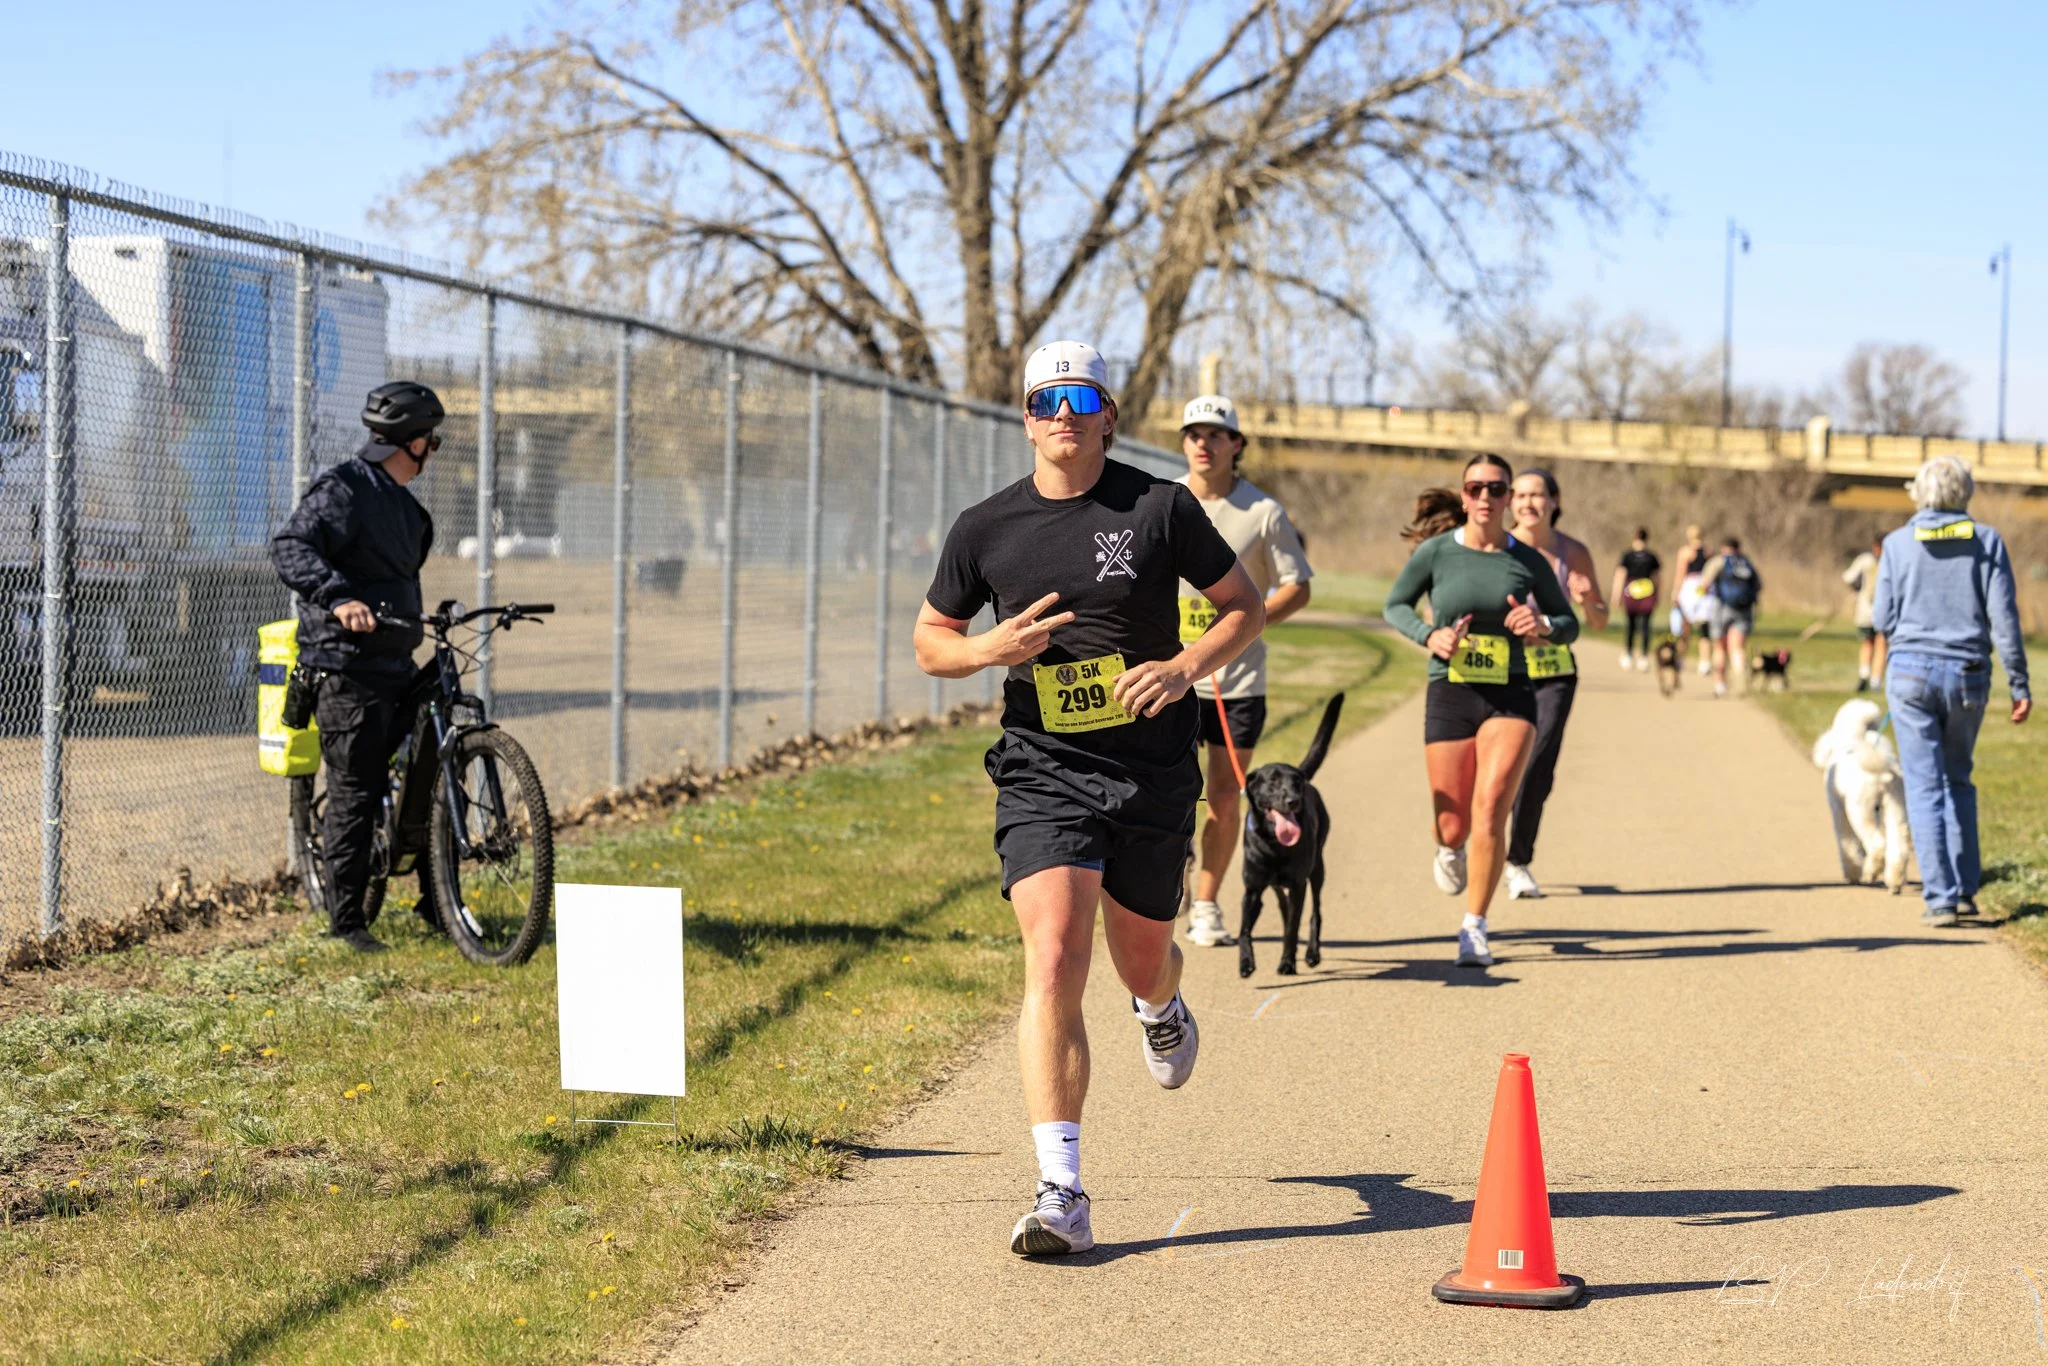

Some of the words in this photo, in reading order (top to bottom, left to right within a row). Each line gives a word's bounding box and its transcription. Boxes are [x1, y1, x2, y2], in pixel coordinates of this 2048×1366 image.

[1056, 361, 1069, 373] 13
[1464, 651, 1494, 668] 486
[1081, 662, 1102, 679] 5K
[1057, 684, 1107, 713] 299
